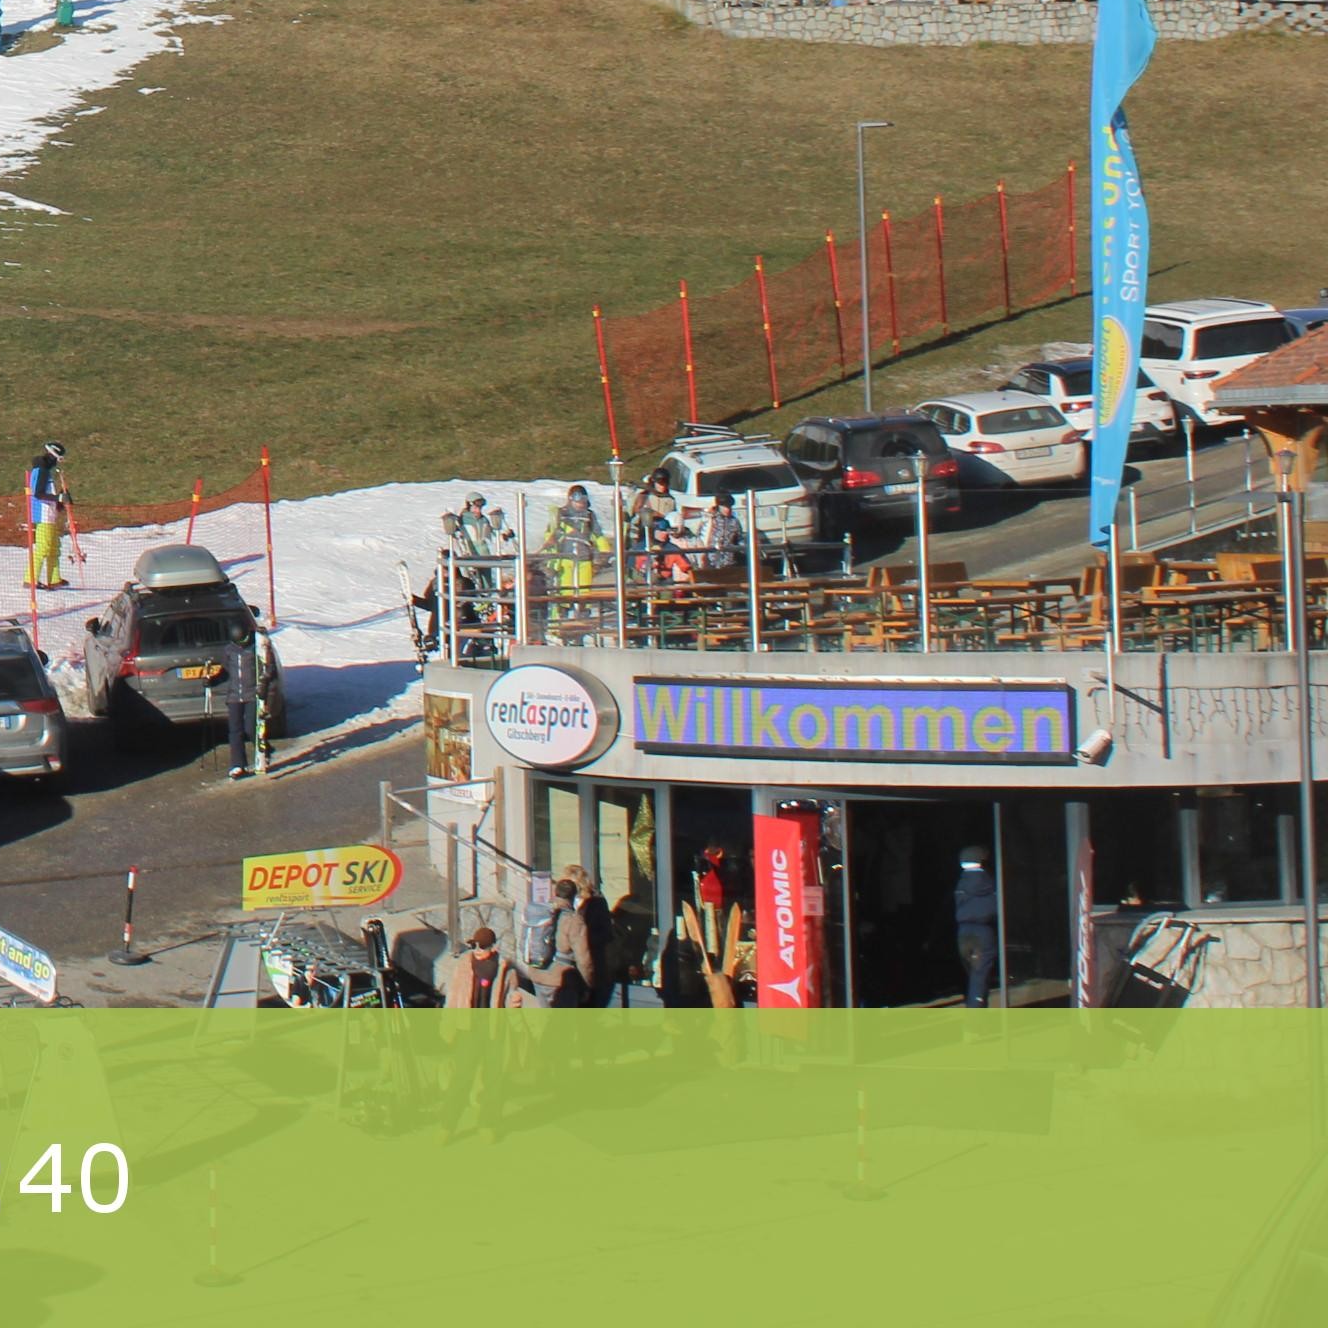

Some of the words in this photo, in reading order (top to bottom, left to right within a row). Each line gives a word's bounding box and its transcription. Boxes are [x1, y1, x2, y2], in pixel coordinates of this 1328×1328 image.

[1119, 218, 1141, 302] SPORT
[490, 691, 589, 742] rentasport
[506, 727, 546, 744] Gitschberg
[637, 685, 1064, 752] Willkommen
[248, 863, 339, 891] DEPOT
[342, 859, 389, 886] SKI
[347, 883, 382, 894] SERVICE
[772, 848, 795, 970] ATOMIC
[8, 946, 33, 970] and
[34, 959, 50, 979] go
